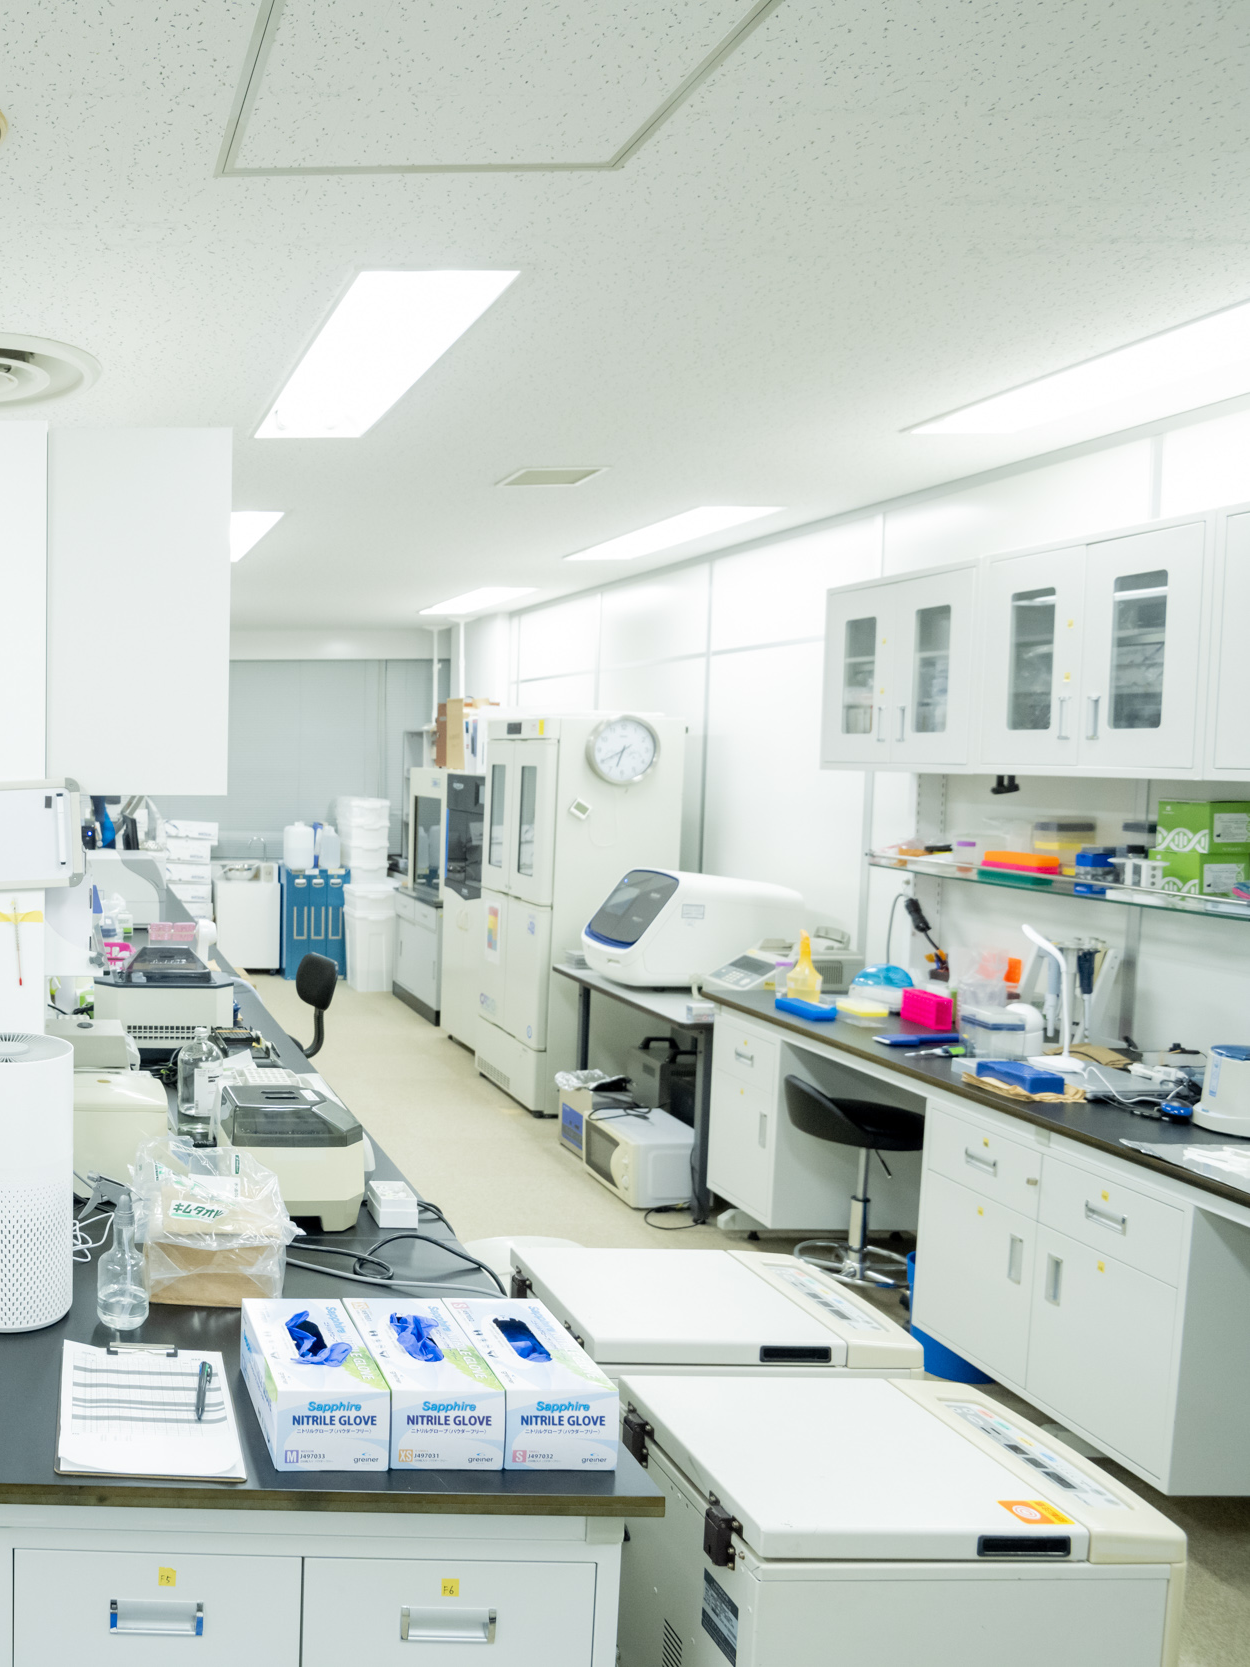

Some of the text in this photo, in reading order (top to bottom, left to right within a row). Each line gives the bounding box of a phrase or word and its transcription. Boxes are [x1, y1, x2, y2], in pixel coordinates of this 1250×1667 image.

[353, 1357, 375, 1380] GLOVE
[463, 1356, 488, 1379] GLOVE
[307, 1401, 362, 1413] Sapphire
[422, 1401, 476, 1413] Sapphire
[536, 1401, 590, 1413] Sapphire
[292, 1415, 377, 1426] NITRILE GLOVE
[406, 1415, 492, 1426] NITRILE GLOVE
[520, 1415, 606, 1426] NITRILE GLOVE
[287, 1451, 297, 1463] M
[353, 1456, 379, 1464] greiner
[399, 1450, 412, 1462] XS
[468, 1456, 493, 1464] greiner
[515, 1451, 523, 1462] S
[160, 1574, 172, 1584] F5
[443, 1585, 454, 1595] F6
